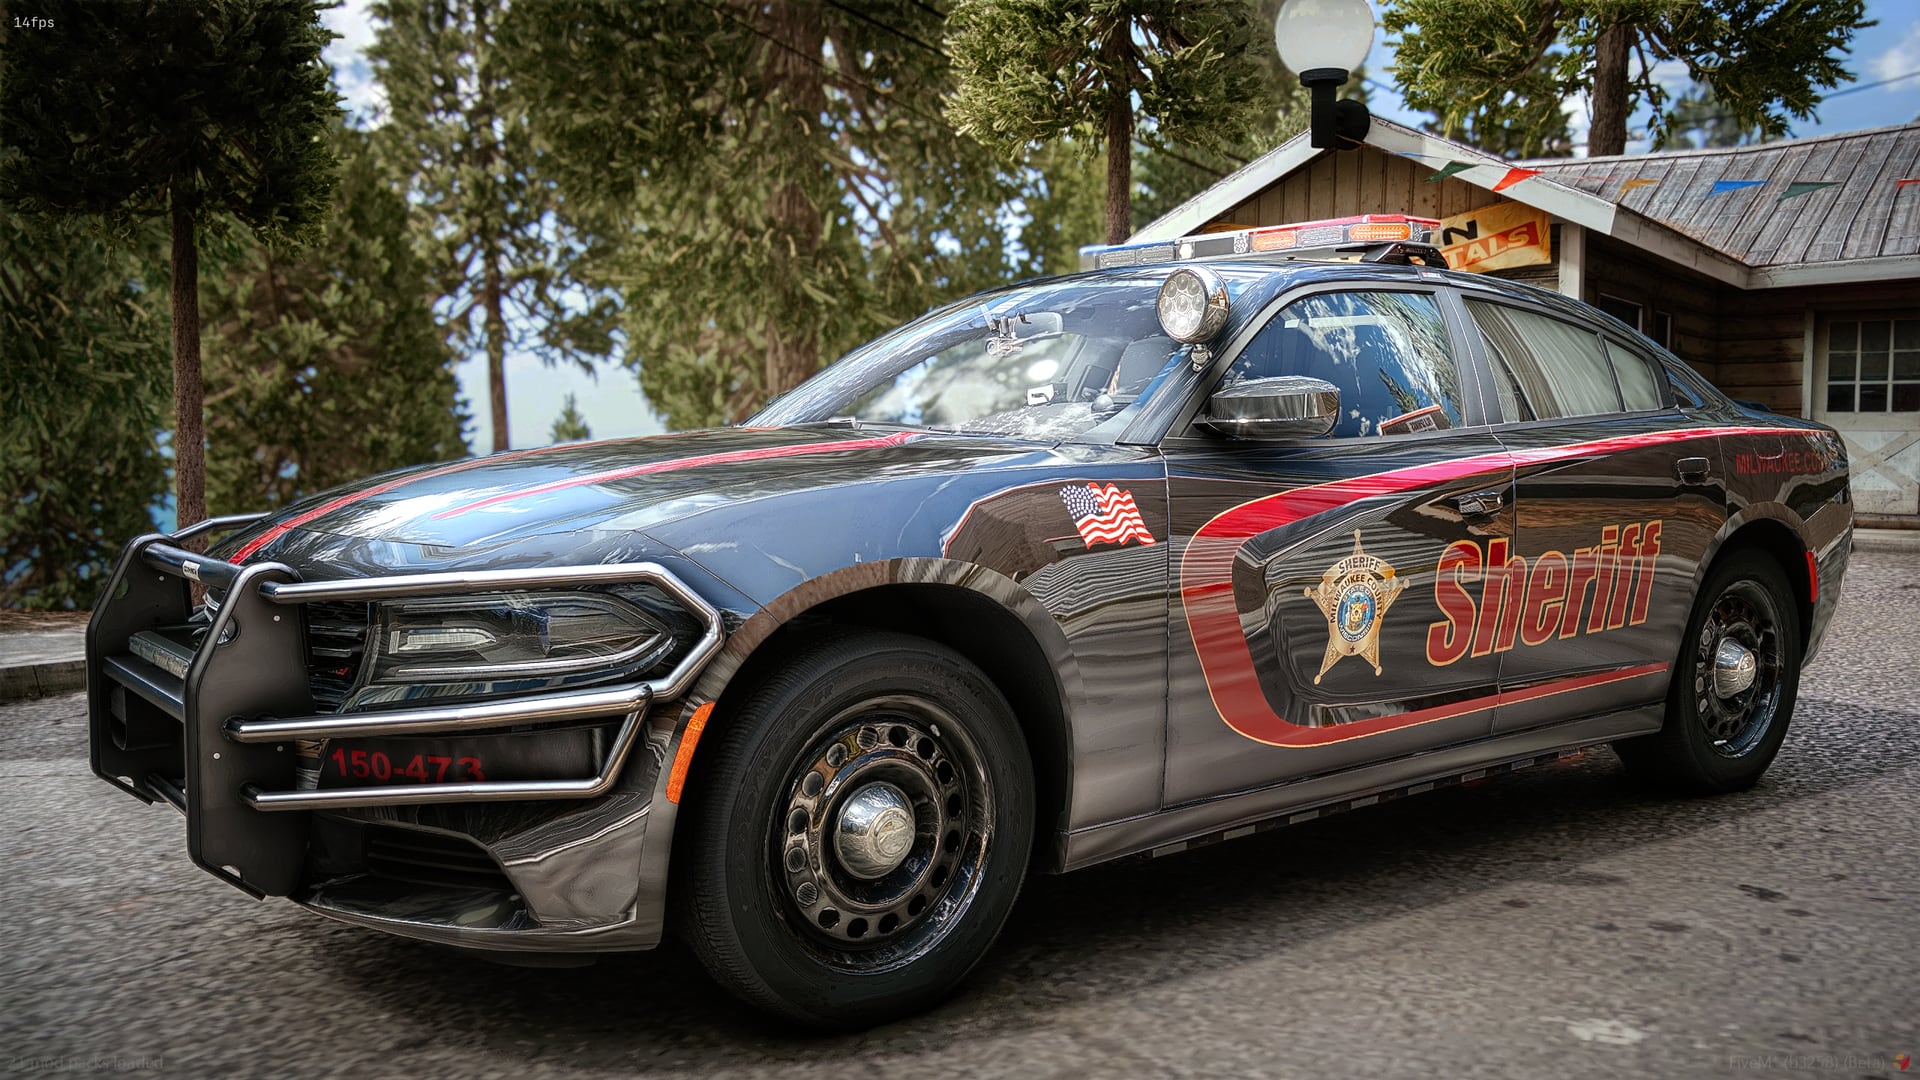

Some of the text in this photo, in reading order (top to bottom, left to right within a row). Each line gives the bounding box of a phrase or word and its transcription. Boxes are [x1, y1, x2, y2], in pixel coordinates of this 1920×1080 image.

[1443, 219, 1478, 246] N
[1735, 451, 1802, 474] MILWAUKEE
[1338, 556, 1381, 574] SHERIFF
[1330, 574, 1382, 623] MILWAUKEE COUNTY
[1426, 520, 1662, 667] Sheriff
[332, 747, 485, 783] 150-473
